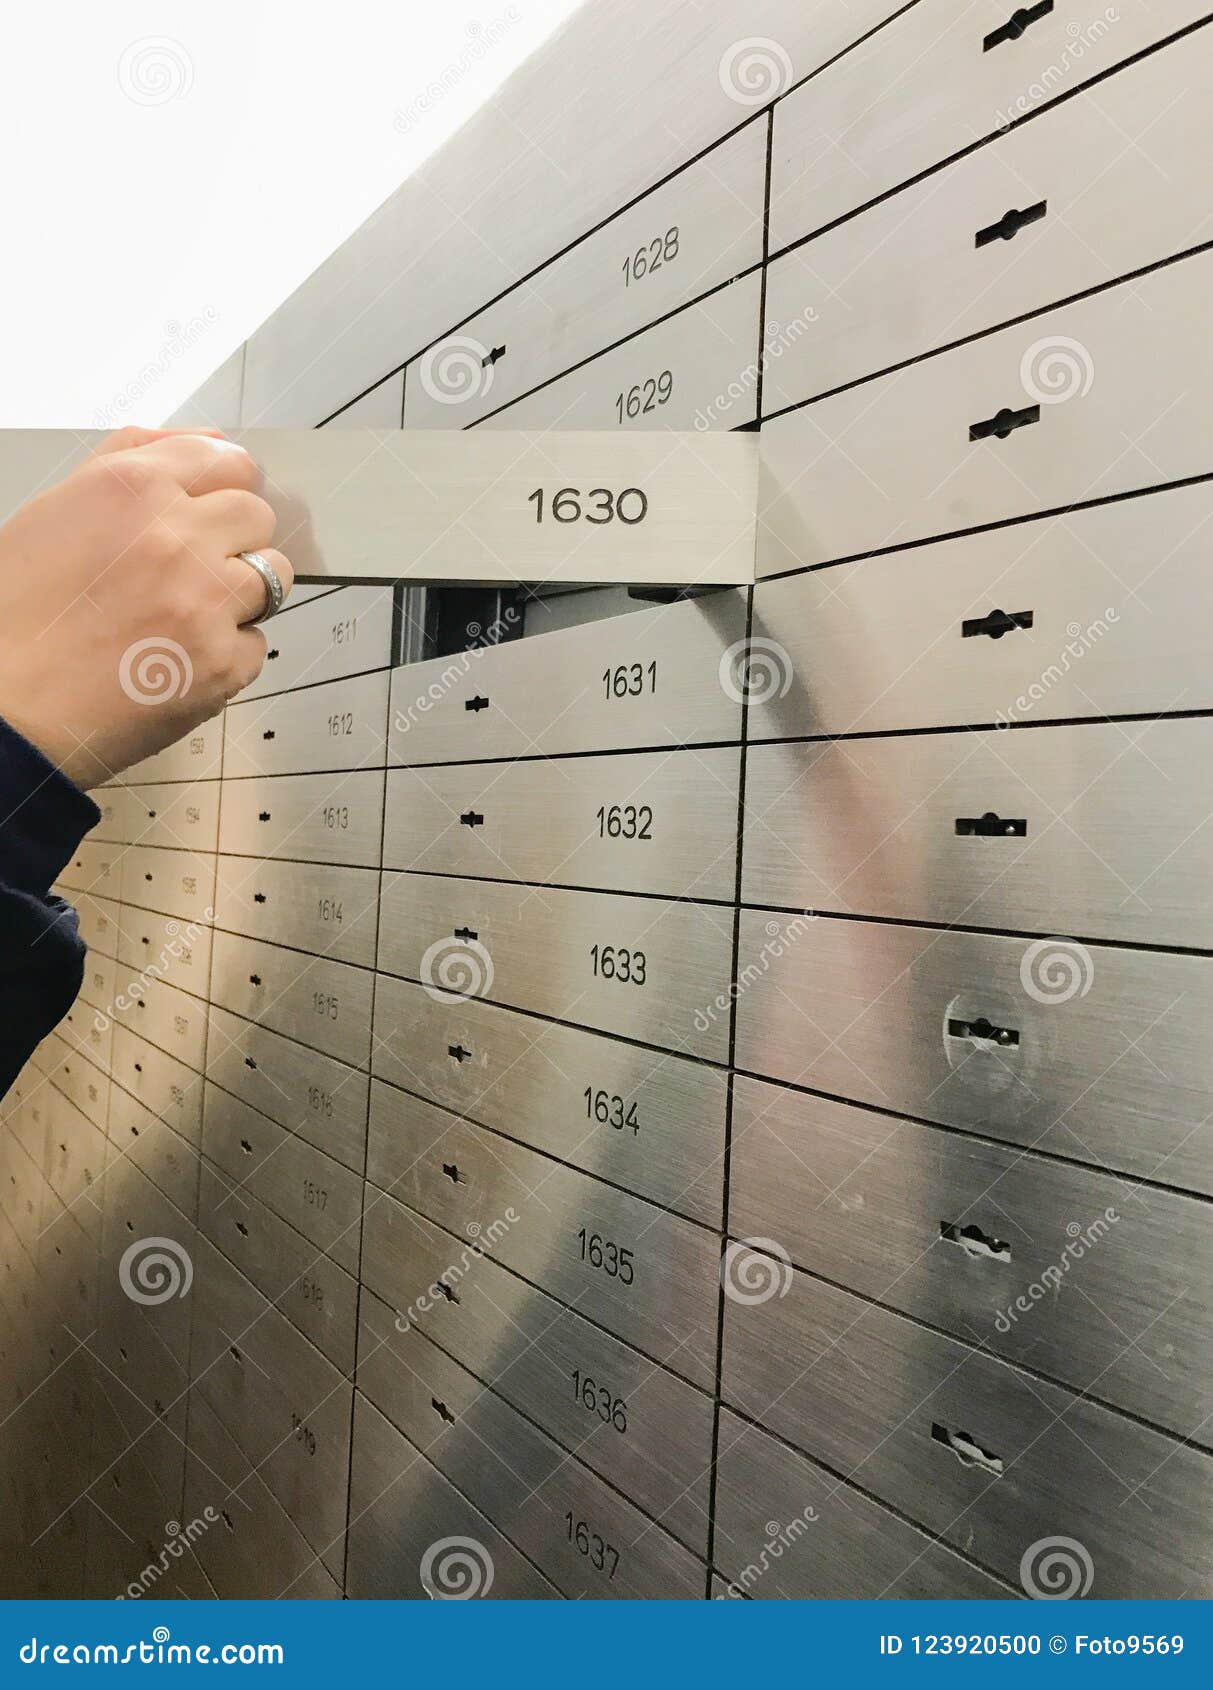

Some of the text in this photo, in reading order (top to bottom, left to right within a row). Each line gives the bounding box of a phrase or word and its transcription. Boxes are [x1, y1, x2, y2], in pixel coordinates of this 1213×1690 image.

[622, 226, 679, 287] 1628
[616, 370, 673, 424] 1629
[528, 488, 648, 525] 1630
[331, 618, 358, 645] 1611
[602, 660, 657, 700] 1631
[328, 712, 353, 736] 1612
[322, 807, 348, 830] 1613
[596, 806, 653, 839] 1632
[318, 899, 343, 923] 1614
[590, 944, 646, 986] 1633
[312, 991, 338, 1021] 1615
[584, 1086, 640, 1137] 1634
[578, 1228, 634, 1286] 1635
[571, 1370, 627, 1434] 1636
[565, 1511, 620, 1580] 1637
